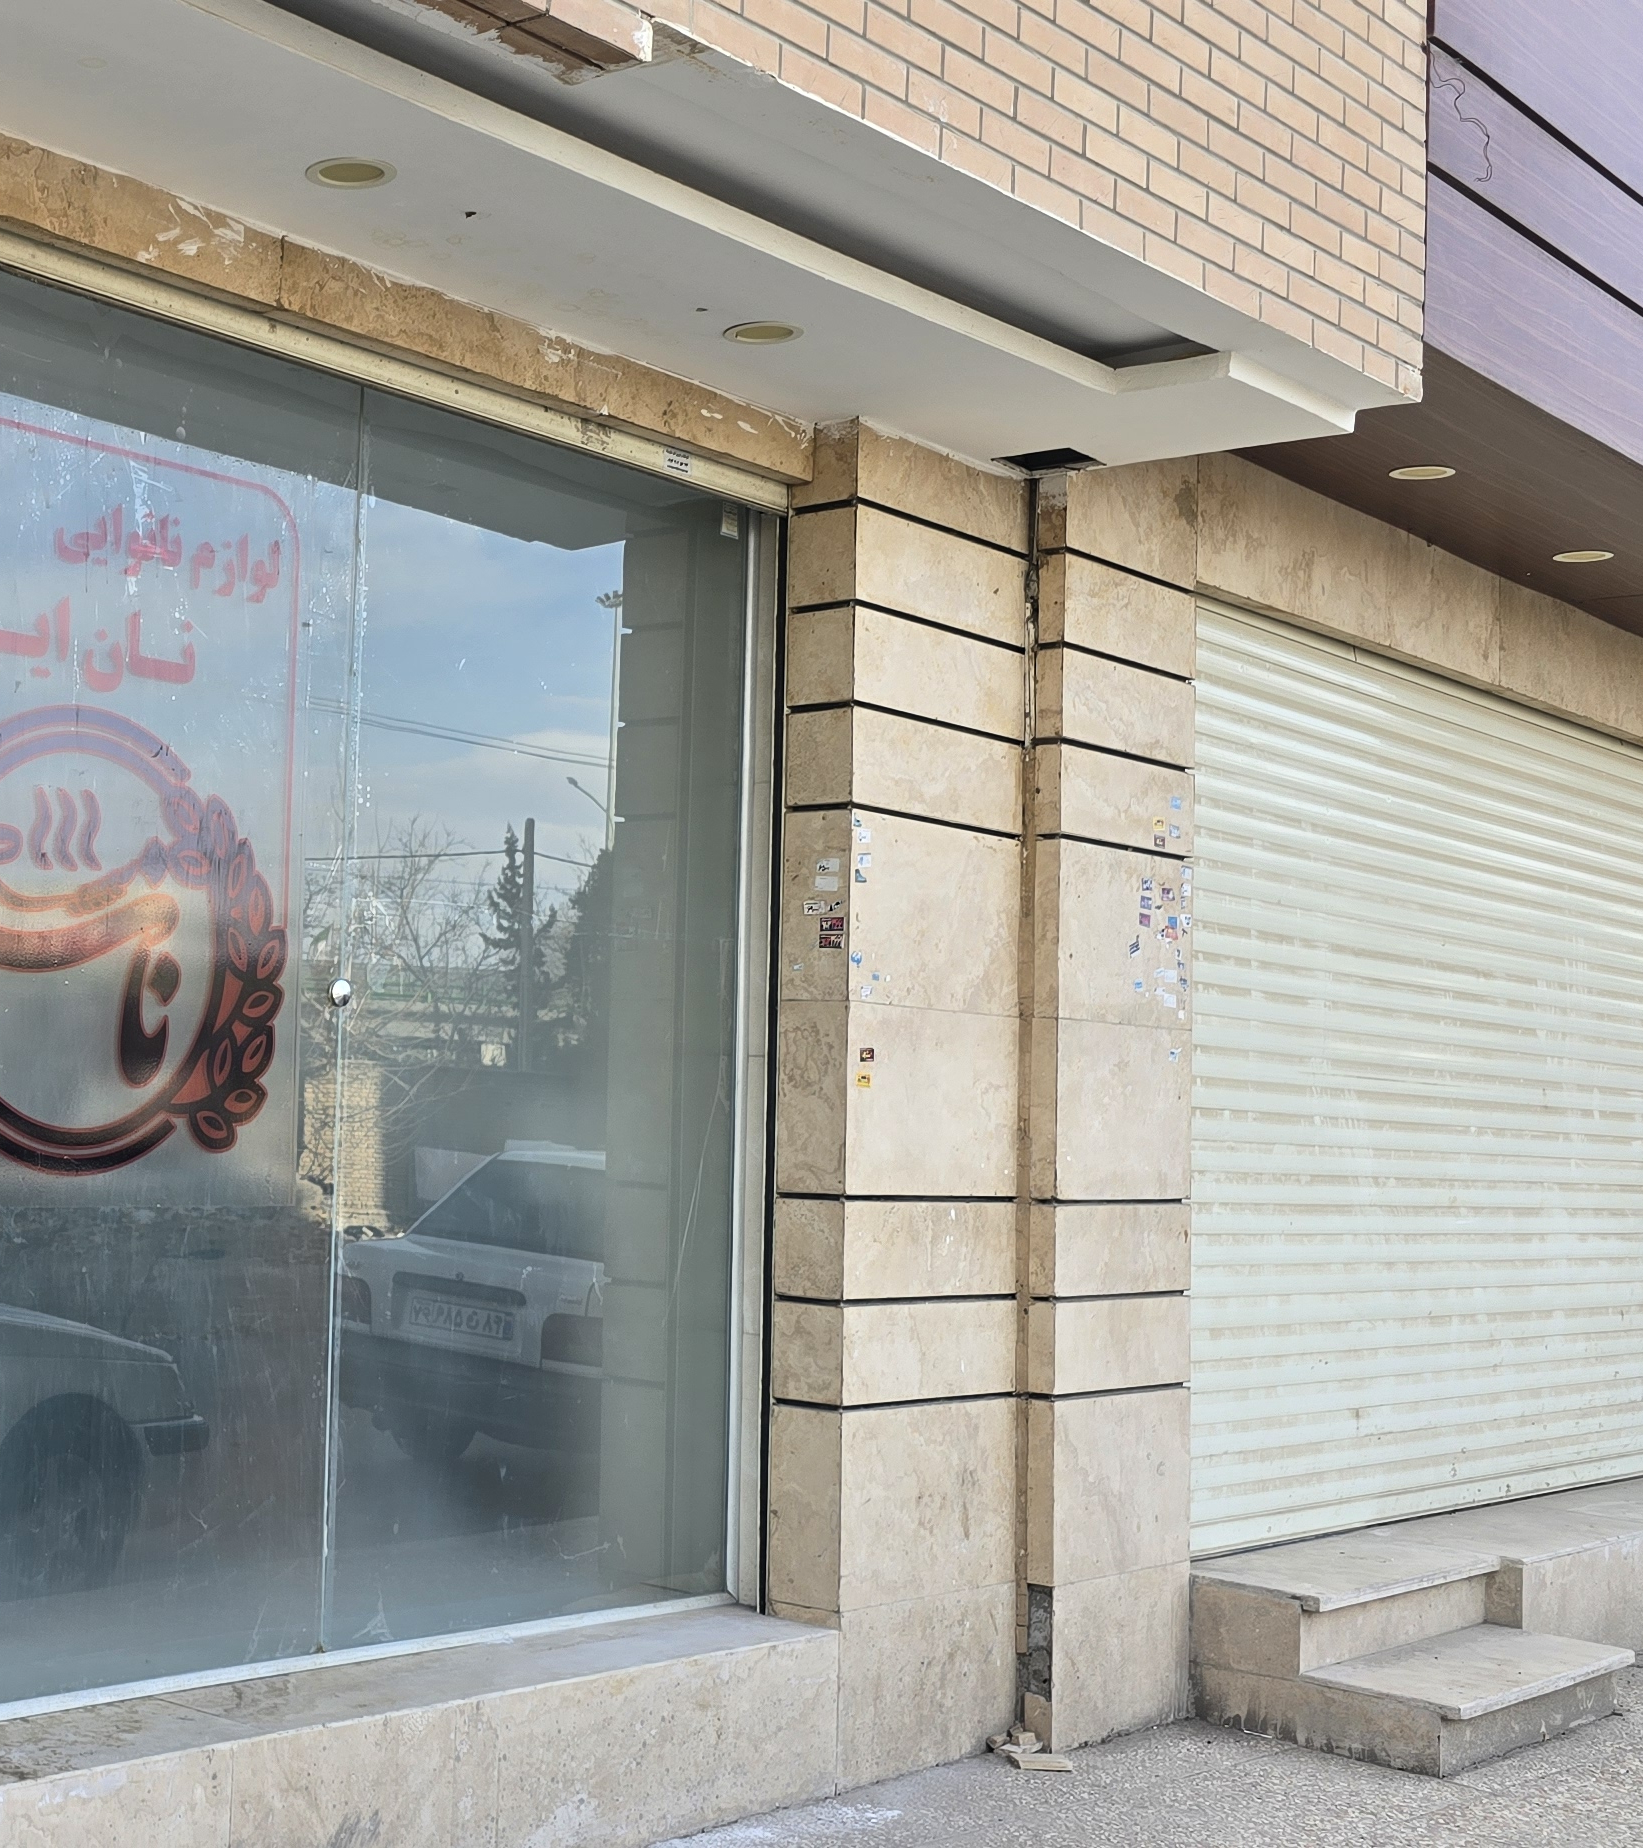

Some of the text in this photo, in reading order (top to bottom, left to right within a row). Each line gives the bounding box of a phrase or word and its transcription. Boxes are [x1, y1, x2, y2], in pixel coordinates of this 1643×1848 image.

[54, 502, 280, 603] لوازم نانوایی
[83, 608, 196, 692] نان
